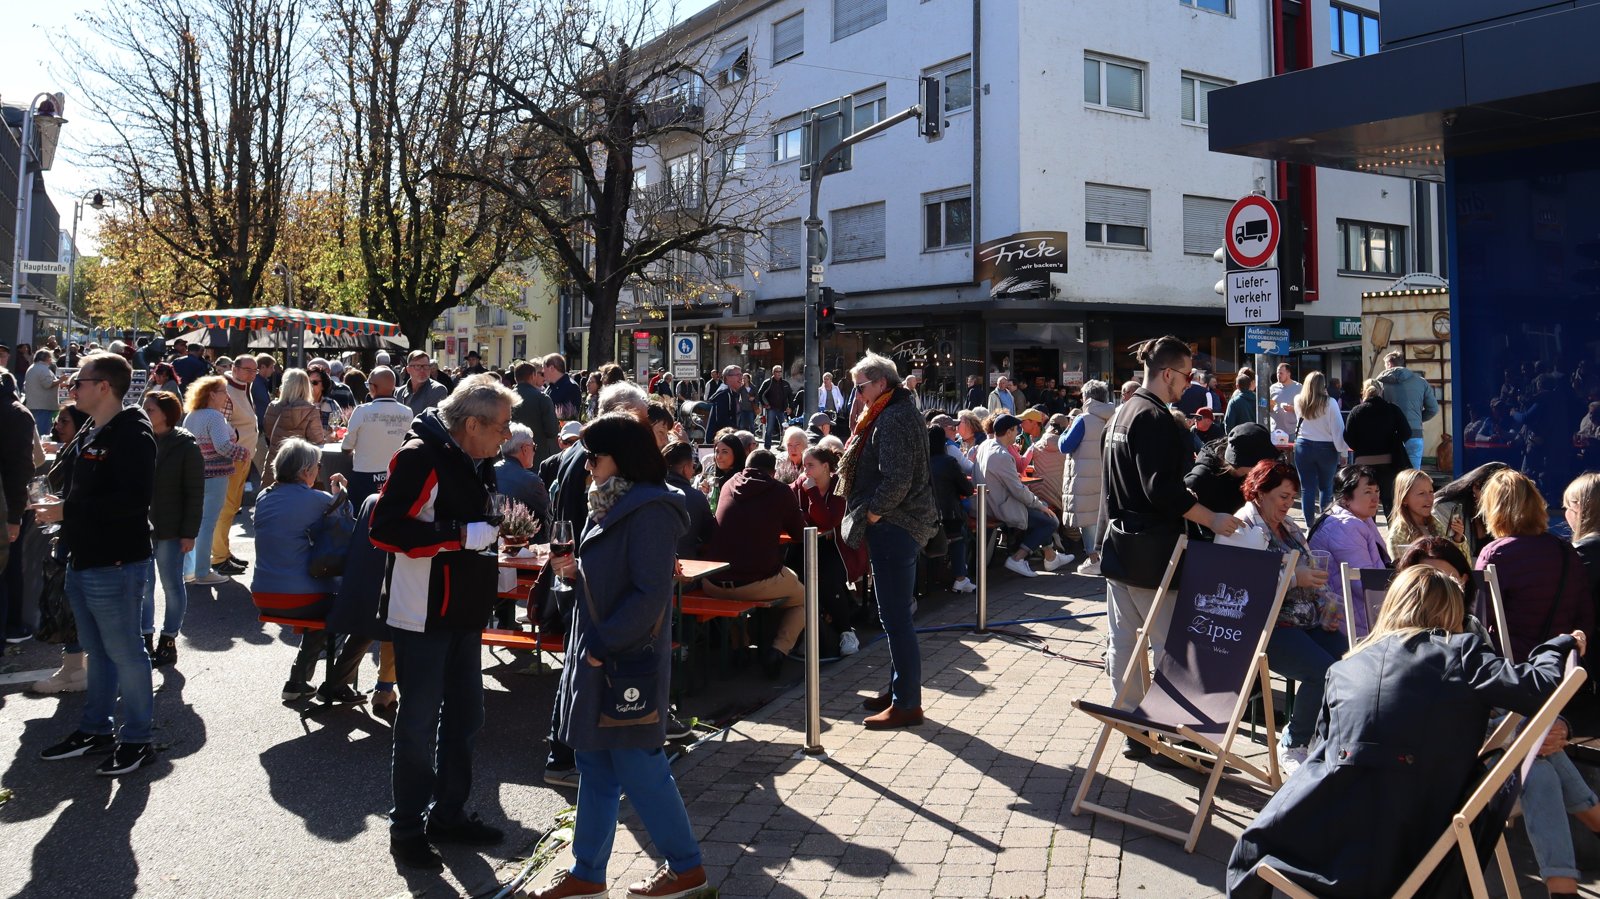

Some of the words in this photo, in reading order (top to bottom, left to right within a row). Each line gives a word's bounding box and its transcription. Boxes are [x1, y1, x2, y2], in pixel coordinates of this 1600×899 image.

[23, 262, 66, 272] Hauptstraße
[1235, 276, 1269, 289] Liefer-
[1234, 291, 1272, 304] verkehr
[1245, 306, 1262, 318] frei
[1187, 615, 1242, 643] Zipse
